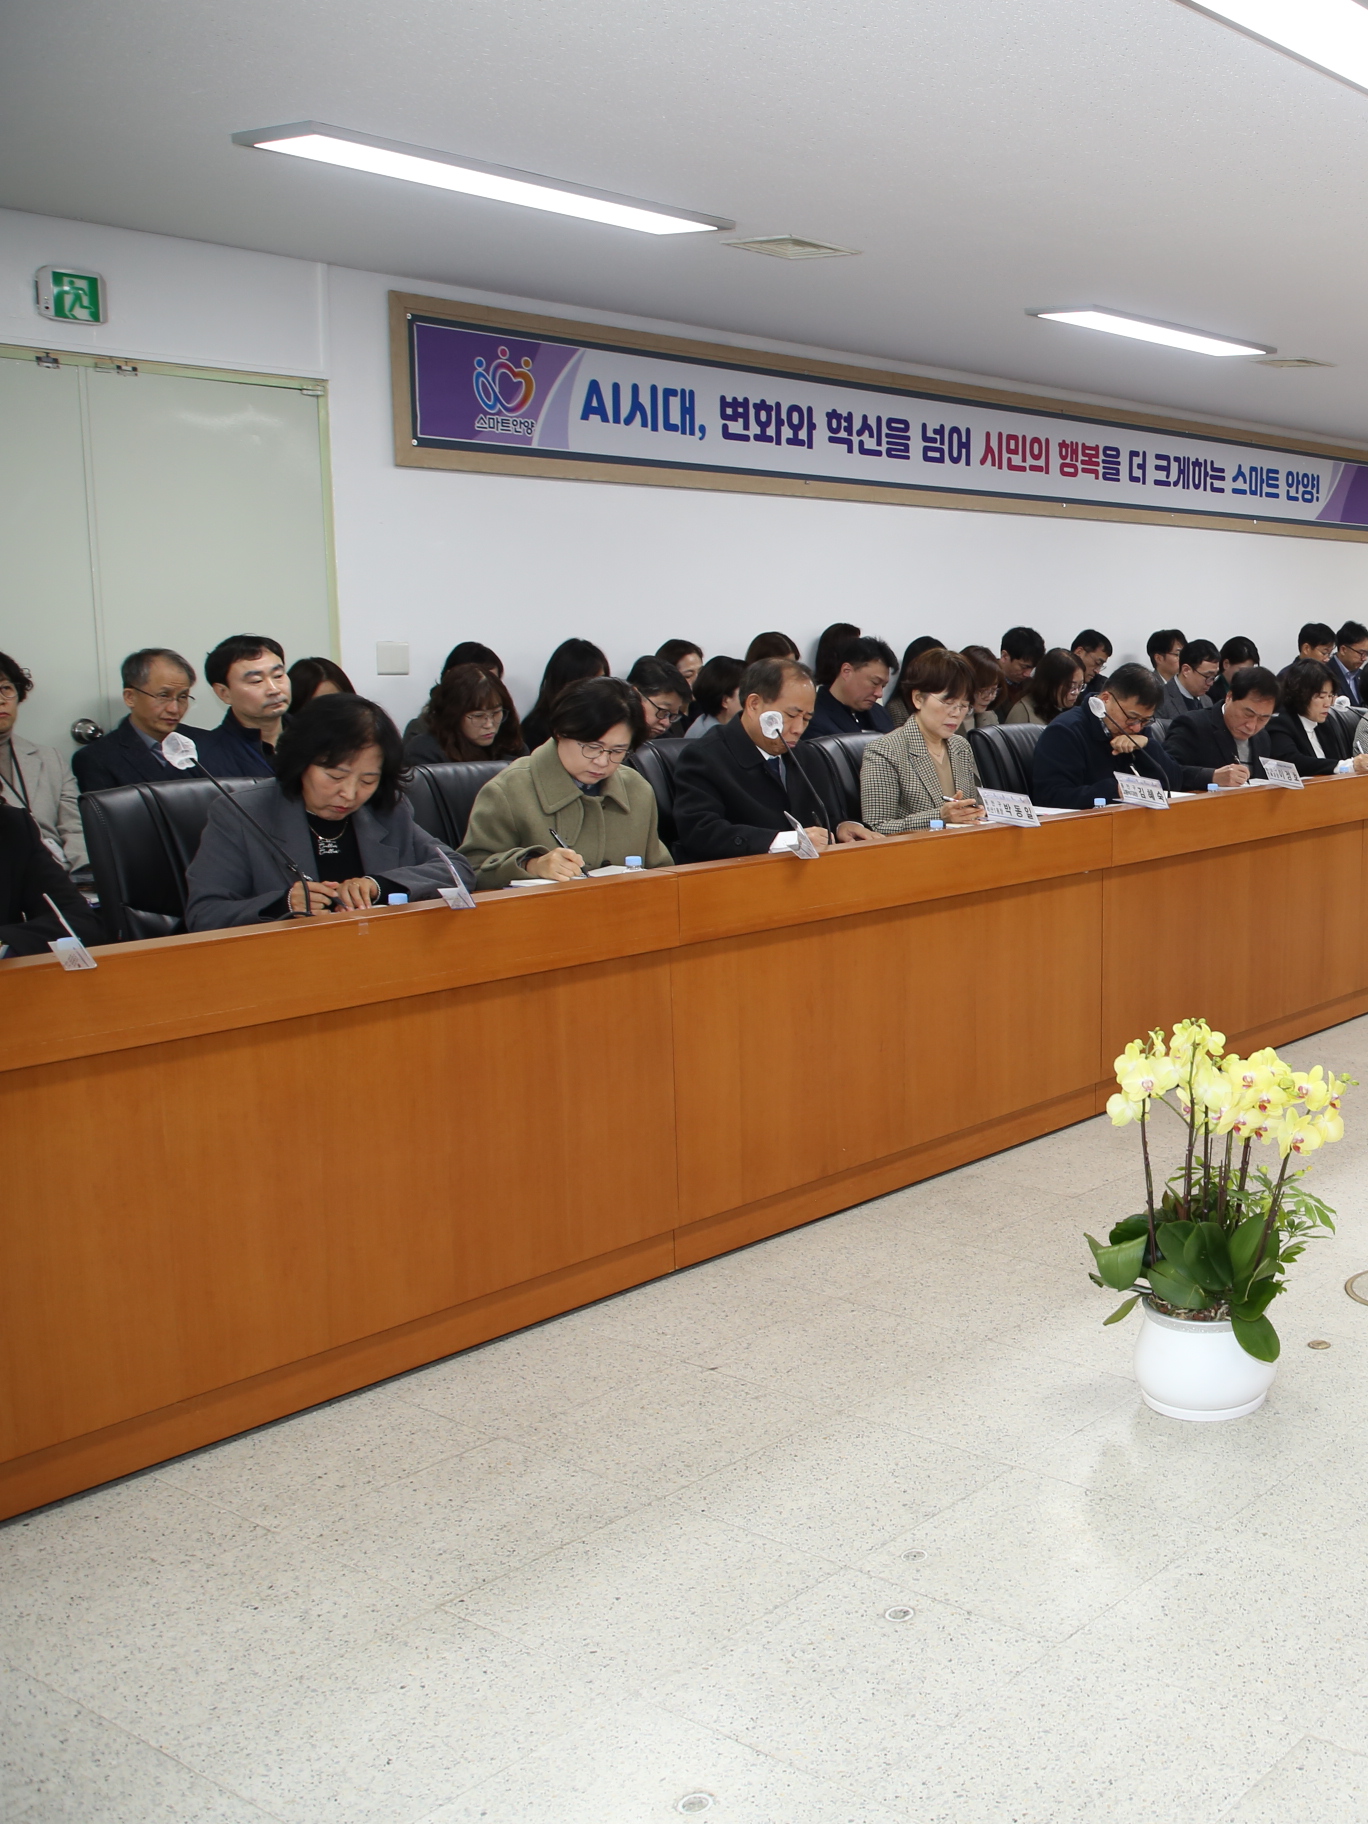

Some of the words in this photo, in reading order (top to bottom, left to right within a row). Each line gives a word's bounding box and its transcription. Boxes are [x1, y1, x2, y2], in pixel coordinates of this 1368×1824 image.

[474, 415, 536, 437] 스마트안양
[580, 378, 707, 441] AI시대,
[719, 395, 817, 450] 변화와
[825, 408, 911, 461] 혁신을
[921, 422, 971, 467] 넘어
[980, 431, 1050, 475] 시민의
[1058, 440, 1121, 482] 행복을
[1128, 450, 1147, 486] 더
[1153, 453, 1226, 494] 크게하는
[1231, 463, 1280, 499] 스마트
[1286, 471, 1321, 504] 안양!
[1003, 803, 1034, 820] 박동일
